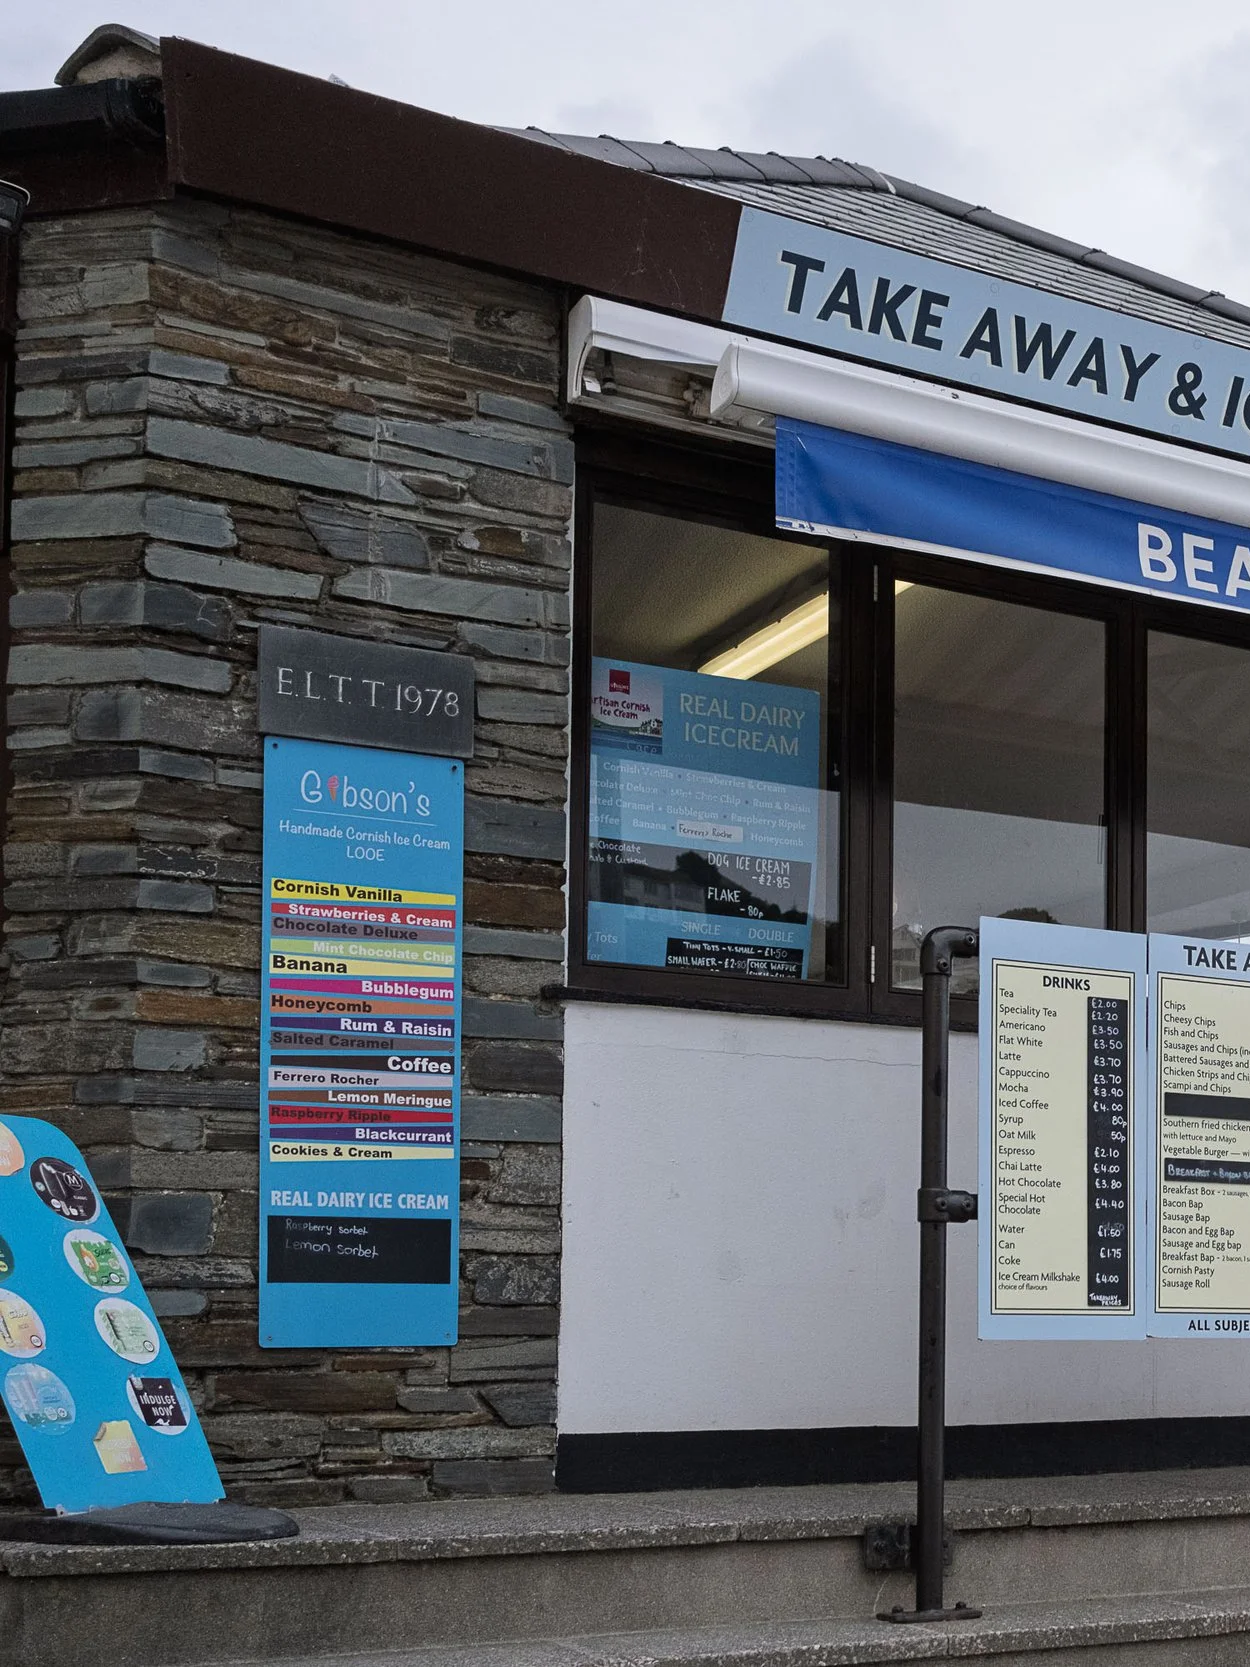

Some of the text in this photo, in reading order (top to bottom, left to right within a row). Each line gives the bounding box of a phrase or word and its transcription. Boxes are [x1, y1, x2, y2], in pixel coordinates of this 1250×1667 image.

[781, 250, 950, 351] TAKE
[961, 306, 1161, 403] AWAY
[1167, 361, 1205, 420] &
[395, 684, 459, 717] 1978
[621, 700, 650, 712] Cornish
[600, 707, 638, 719] Ice Cream
[680, 693, 805, 729] REAL DAIRY
[685, 723, 798, 756] ICECREAM
[280, 820, 450, 850] Handmade Cornish Ice Cream
[347, 846, 384, 861] LOOE
[708, 852, 790, 875] DOG ICE CREAM
[273, 879, 402, 902] Cornish Vanilla
[708, 887, 740, 903] FLAKE
[288, 904, 453, 928] Strawberries & Cream
[273, 917, 418, 940] Chocolate Deluxe
[681, 921, 794, 943] SINGLE DOUBLE
[596, 932, 618, 943] Tots
[313, 942, 453, 963] Mint Chocolate Chip
[1183, 945, 1237, 970] TAKE
[272, 955, 347, 973] Banana
[668, 955, 690, 965] SMALL
[361, 981, 453, 999] Bubblegum
[1043, 976, 1090, 991] DRINKS
[1000, 989, 1014, 997] Tea
[272, 995, 372, 1013] Honeycomb
[1092, 998, 1117, 1009] £2.00
[999, 1004, 1057, 1018] Speciality Tea
[340, 1018, 451, 1036] Rum & Raisin
[999, 1020, 1045, 1031] Americano
[1164, 1014, 1216, 1027] Cheesy Chips
[1092, 1025, 1119, 1035] £3.50
[272, 1032, 393, 1050] Salted Caramel
[999, 1036, 1043, 1047] Flat White
[1164, 1040, 1198, 1051] Sausages
[1201, 1043, 1214, 1052] and
[1216, 1044, 1238, 1055] Chips
[999, 1051, 1021, 1061] Latte
[1094, 1056, 1121, 1067] £3.70
[388, 1056, 451, 1073] Coffee
[274, 1071, 379, 1085] Ferrero Rocher
[999, 1067, 1049, 1079] Cappuccino
[1164, 1067, 1195, 1077] Chicken
[1197, 1070, 1219, 1080] Strips
[1221, 1072, 1234, 1080] and
[328, 1091, 451, 1108] Lemon Meringue
[271, 1107, 391, 1122] Raspberry Ripple
[1112, 1117, 1127, 1128] 80p
[1163, 1118, 1199, 1129] Southern
[1201, 1119, 1220, 1130] fried
[1222, 1121, 1250, 1132] chicken
[355, 1129, 451, 1142] Blackcurrant
[272, 1145, 392, 1159] Cookies & Cream
[1094, 1147, 1119, 1158] £2.10
[1095, 1179, 1122, 1189] £3.80
[271, 1191, 448, 1209] REAL DAIRY ICE CREAM
[1096, 1273, 1119, 1283] £4.00
[1188, 1321, 1210, 1331] ALL
[140, 1395, 176, 1405] INDULGE
[153, 1406, 172, 1416] NOW
